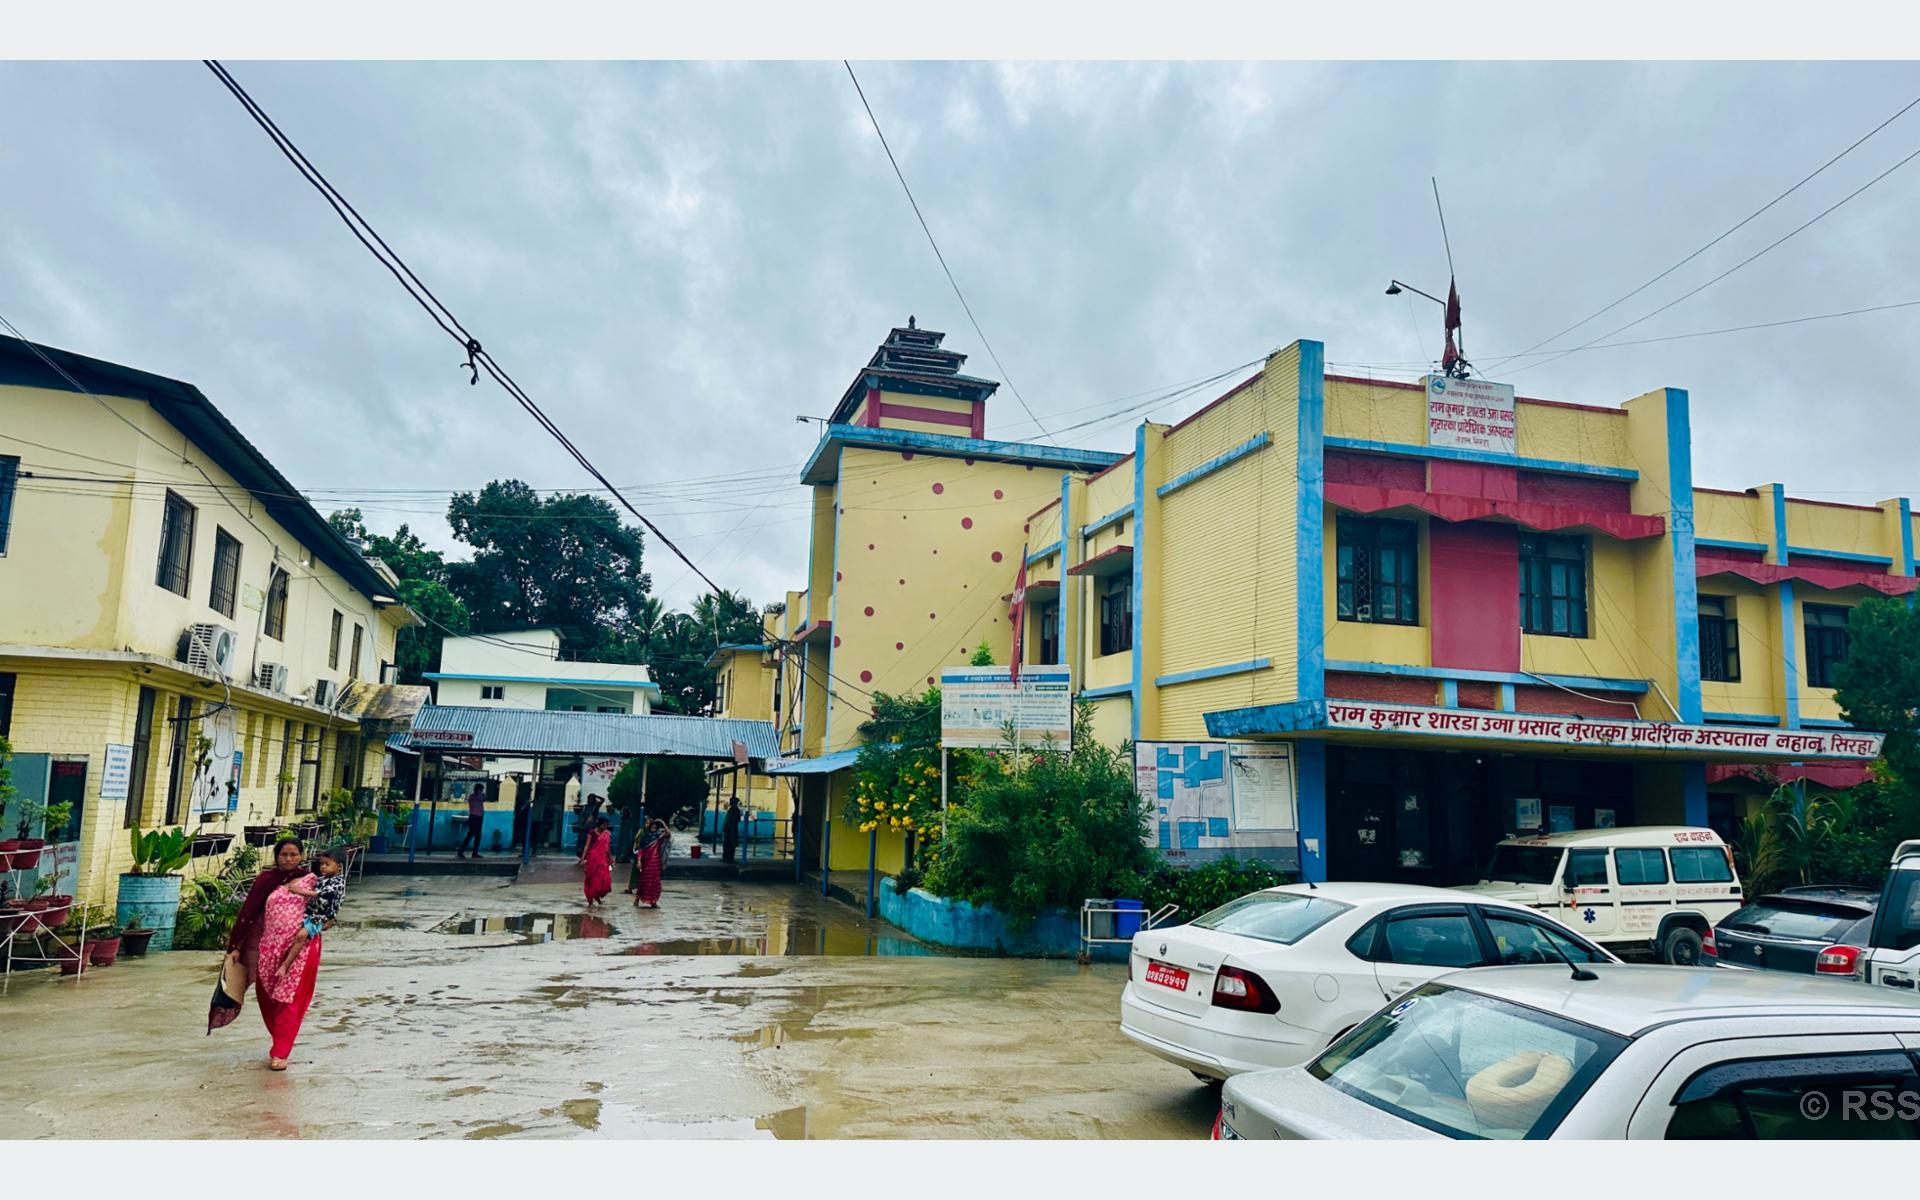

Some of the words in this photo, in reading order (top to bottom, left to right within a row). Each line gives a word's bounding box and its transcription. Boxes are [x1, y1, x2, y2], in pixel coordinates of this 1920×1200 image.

[1329, 705, 1367, 723] राम
[1370, 709, 1424, 730] कुमार
[1428, 712, 1479, 731] शारडा
[1481, 717, 1514, 734] उमा
[1518, 719, 1564, 737] प्रसाद
[1566, 722, 1628, 741] मुरारका
[1632, 723, 1693, 744] प्रादेशिक
[1696, 729, 1771, 748] अस्पताल
